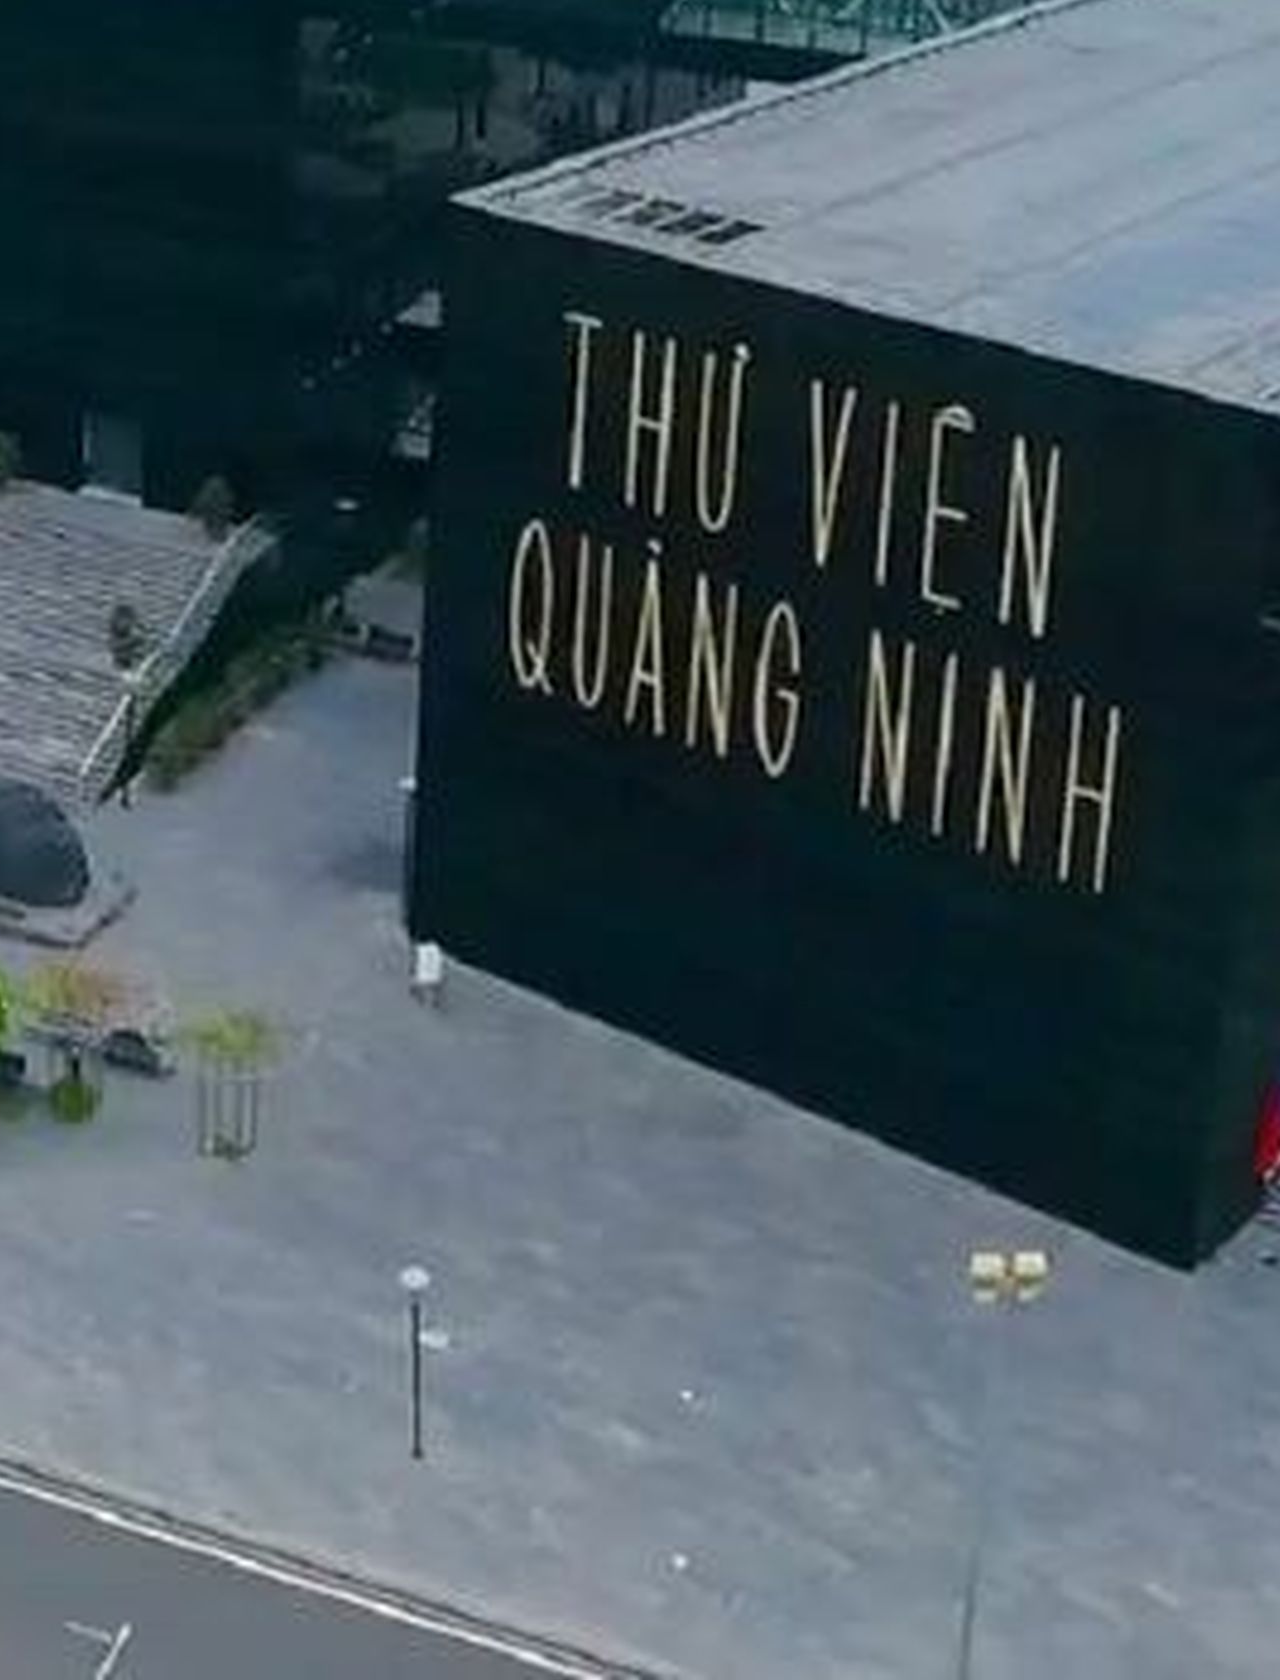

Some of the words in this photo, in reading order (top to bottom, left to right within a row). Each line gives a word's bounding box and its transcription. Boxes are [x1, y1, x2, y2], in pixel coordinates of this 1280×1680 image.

[563, 311, 751, 533] THƯ
[510, 519, 801, 778] QUẢNG
[859, 628, 1120, 893] NINH
